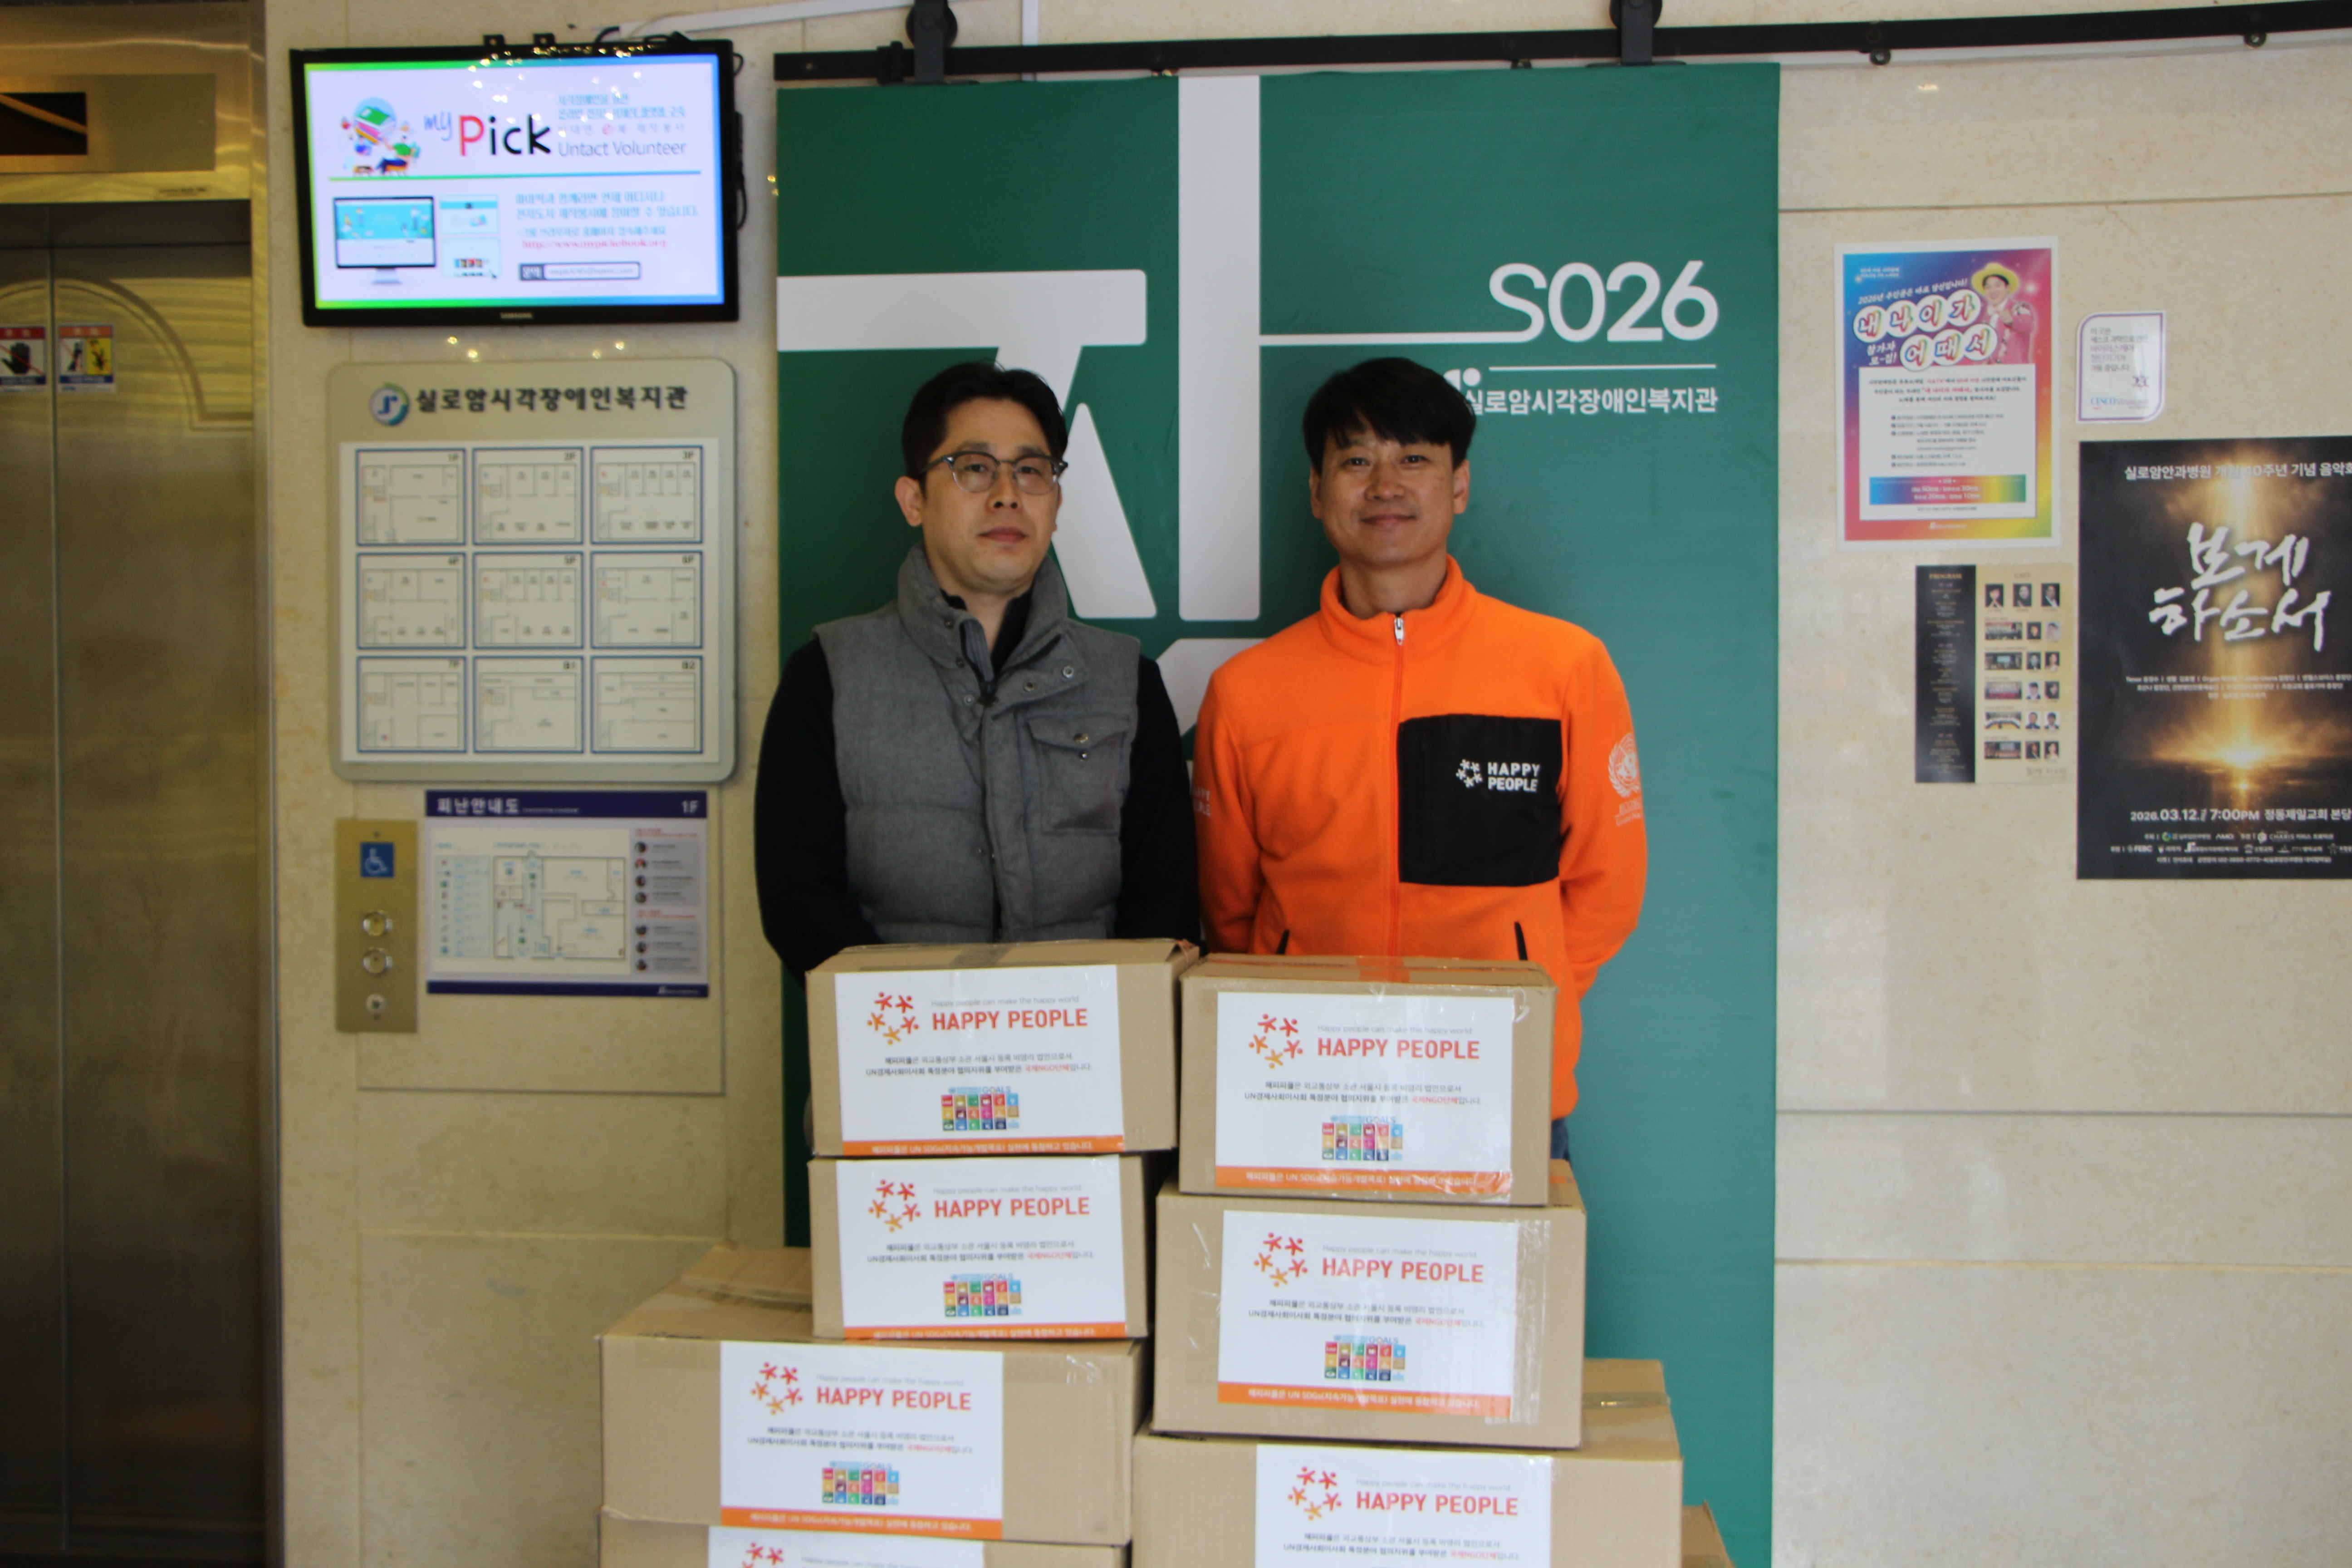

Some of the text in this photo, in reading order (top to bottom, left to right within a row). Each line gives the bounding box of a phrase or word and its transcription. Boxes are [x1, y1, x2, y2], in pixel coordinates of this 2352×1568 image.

[458, 114, 551, 156] Pick
[558, 142, 686, 157] Untact Volunteer
[1867, 341, 1896, 356] 참가자
[1905, 328, 1990, 366] 어때서
[416, 387, 687, 412] 실로암시각장애인복지관
[1466, 387, 1717, 415] 실로암시각장애인복지관
[2124, 465, 2211, 480] 실로암안과병원
[2291, 463, 2316, 477] 기념
[2187, 522, 2309, 590] 보게
[2148, 588, 2332, 651] 하소서
[1488, 762, 1540, 777] HAPPY
[1488, 777, 1539, 793] PEOPLE
[437, 797, 519, 814] 피난안내도
[681, 800, 699, 813] 1F
[932, 1009, 1088, 1030] HAPPY PEOPLE
[1317, 1038, 1480, 1059] HAPPY PEOPLE
[982, 1086, 1011, 1094] GOALS
[934, 1197, 1090, 1218] HAPPY PEOPLE
[1322, 1258, 1485, 1283] HAPPY PEOPLE
[816, 1387, 972, 1411] HAPPY PEOPLE
[1356, 1491, 1519, 1516] HAPPY PEOPLE
